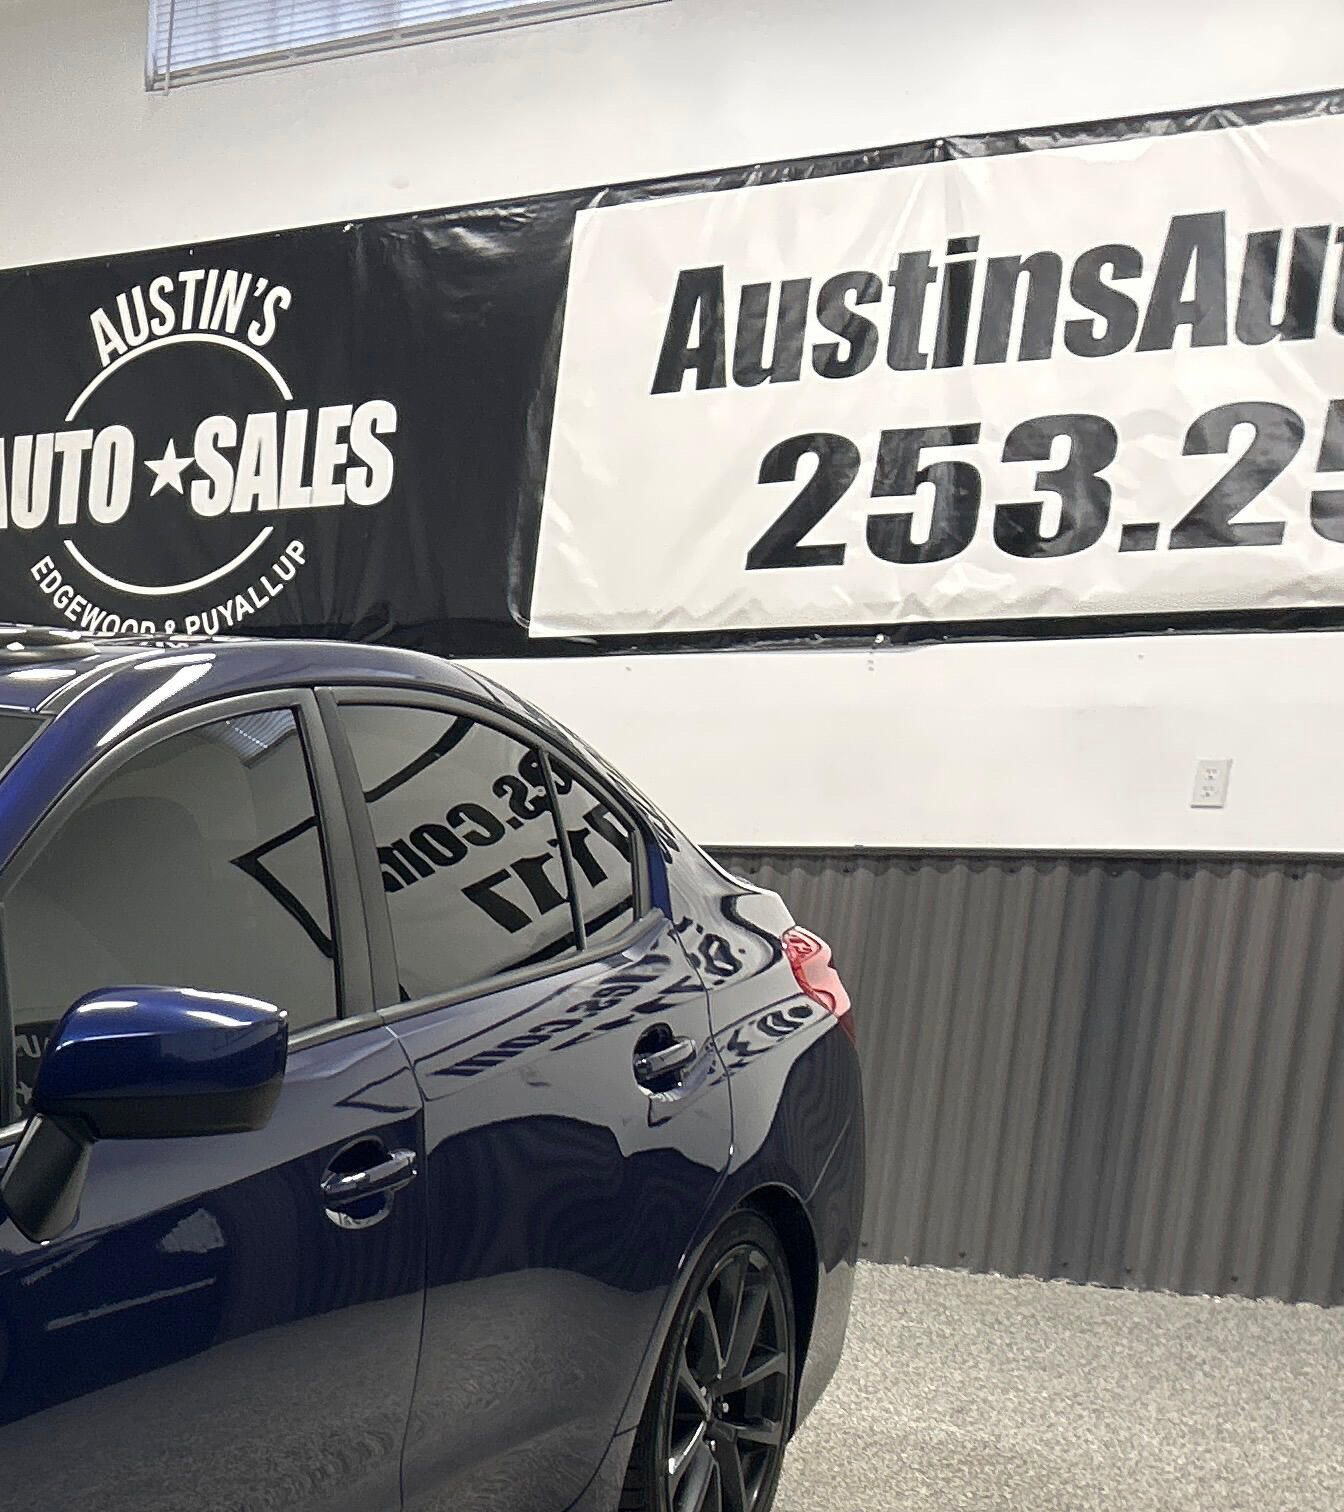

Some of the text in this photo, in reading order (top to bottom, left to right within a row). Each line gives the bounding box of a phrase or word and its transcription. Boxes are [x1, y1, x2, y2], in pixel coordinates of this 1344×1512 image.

[89, 267, 292, 367] AUSTIN'S
[650, 210, 1343, 395] AustinsAu
[190, 399, 398, 518] SALES
[185, 540, 305, 635] PUYALLUP
